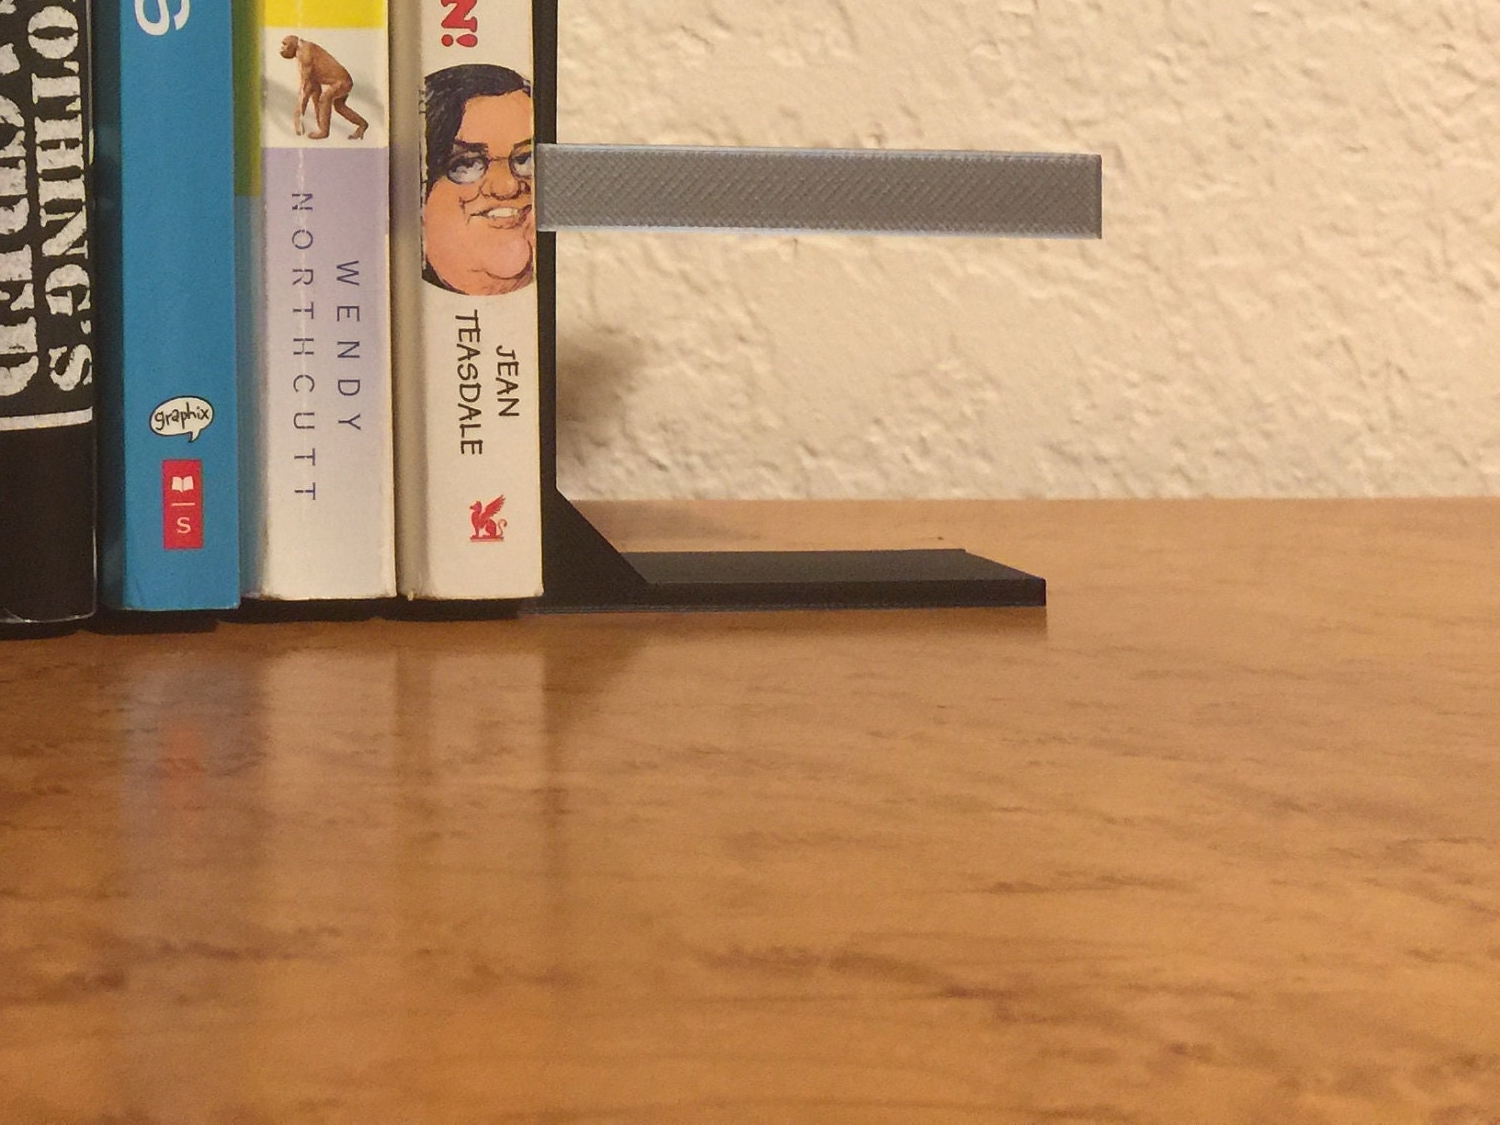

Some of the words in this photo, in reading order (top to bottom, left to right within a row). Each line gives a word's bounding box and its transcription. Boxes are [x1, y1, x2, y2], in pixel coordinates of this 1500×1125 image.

[291, 192, 316, 501] NORTHCUTT
[336, 259, 362, 431] WENDY
[454, 308, 483, 456] TEASDALE
[495, 344, 520, 418] JEAN
[153, 401, 210, 431] graphix
[175, 516, 192, 534] S
